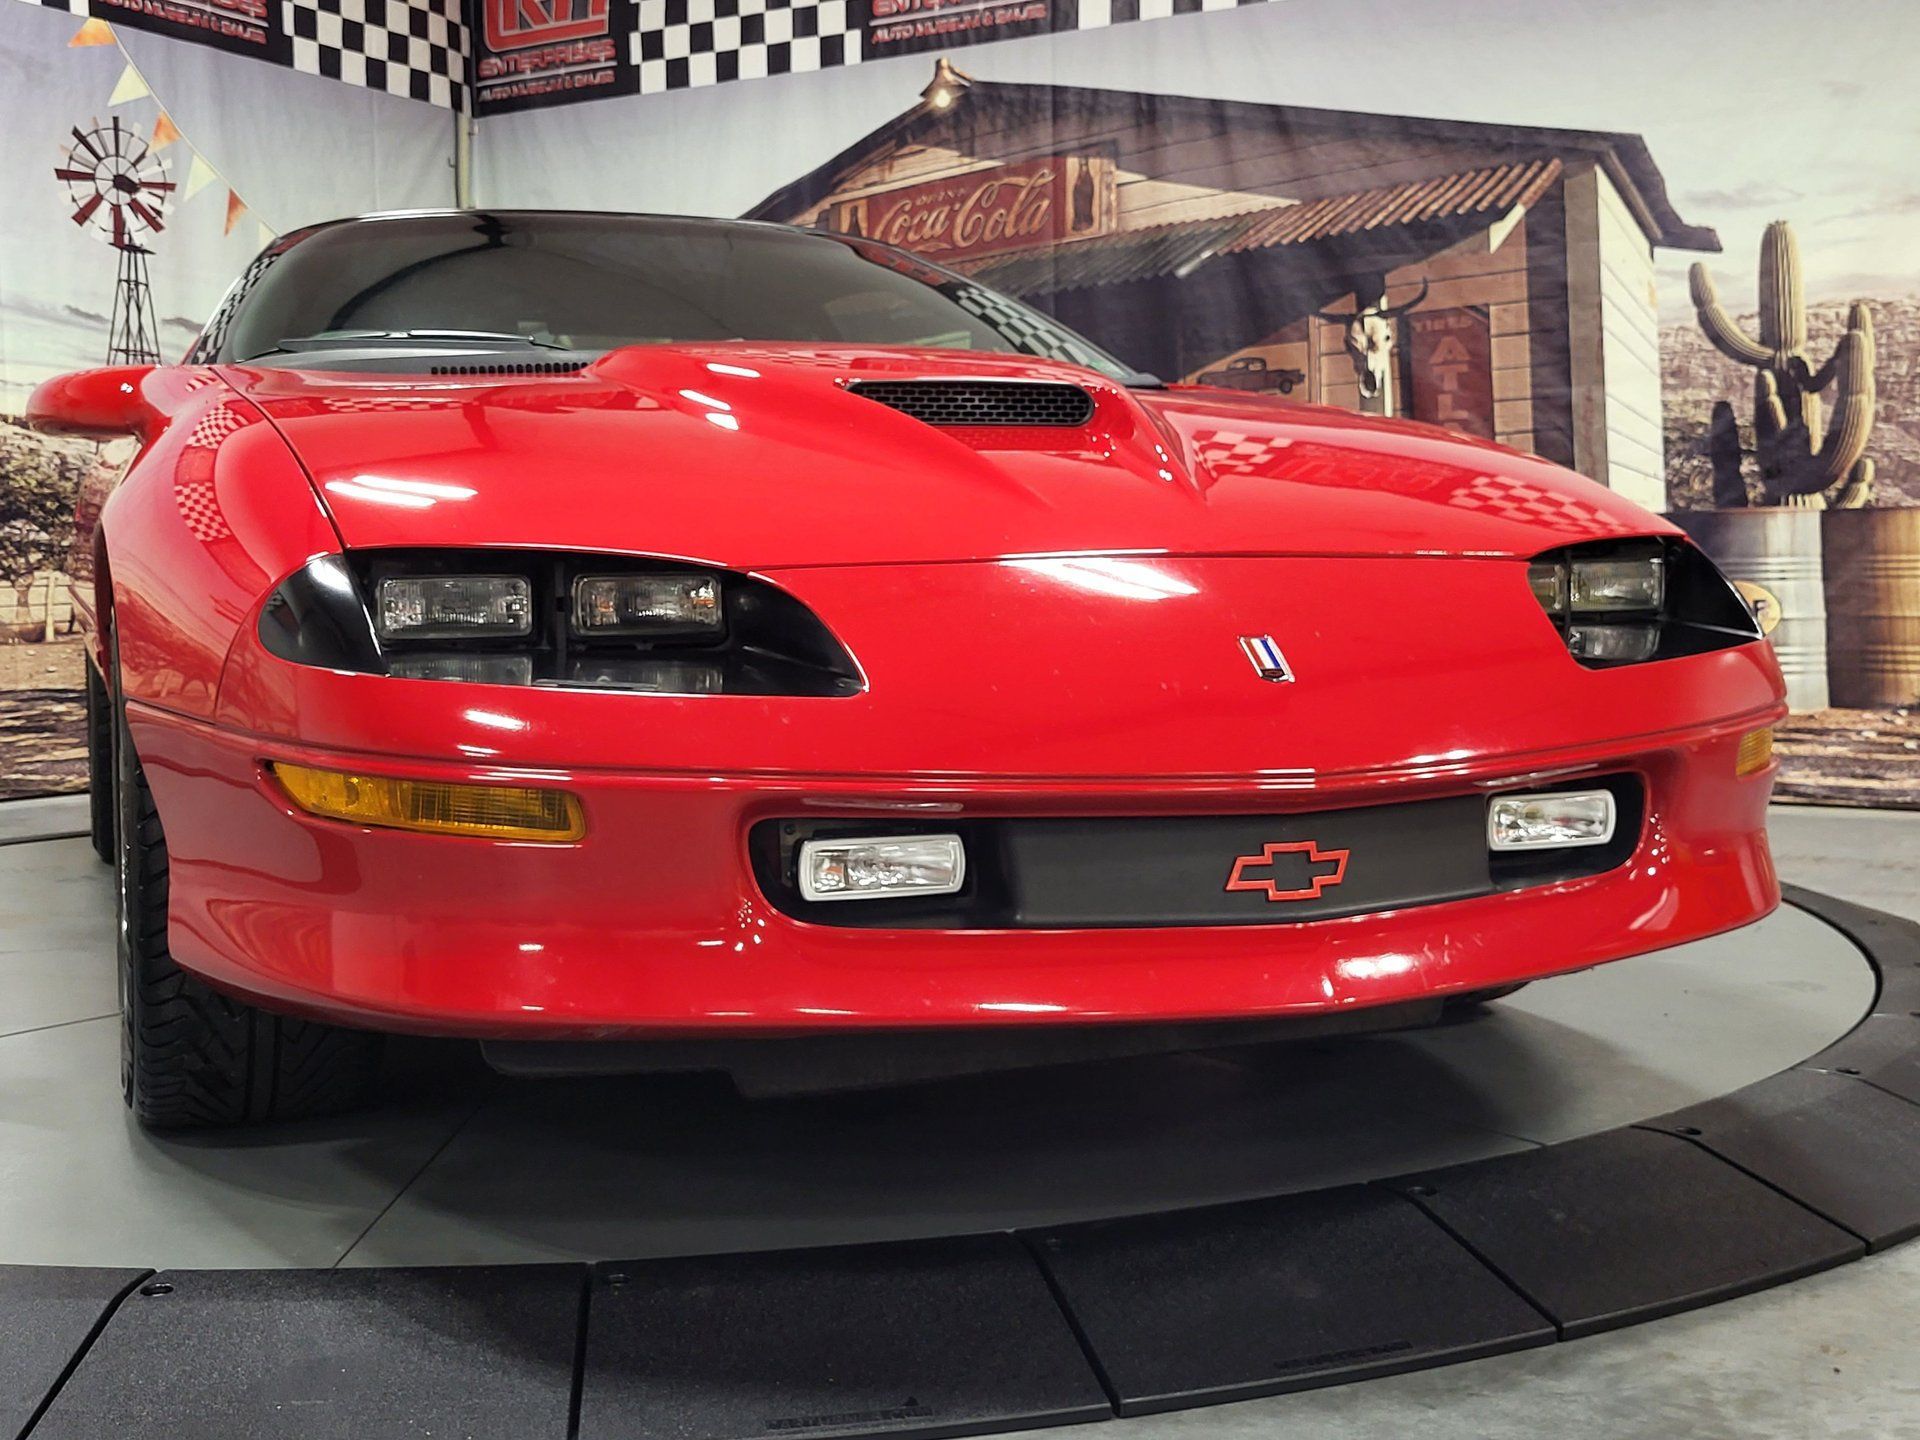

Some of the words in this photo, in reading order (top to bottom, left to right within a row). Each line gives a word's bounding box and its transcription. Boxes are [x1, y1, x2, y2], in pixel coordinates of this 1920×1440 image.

[872, 23, 914, 45] AUTO
[915, 14, 981, 37] MUSEUM
[995, 3, 1047, 24] SALES
[478, 38, 617, 78] ENTERPRISES
